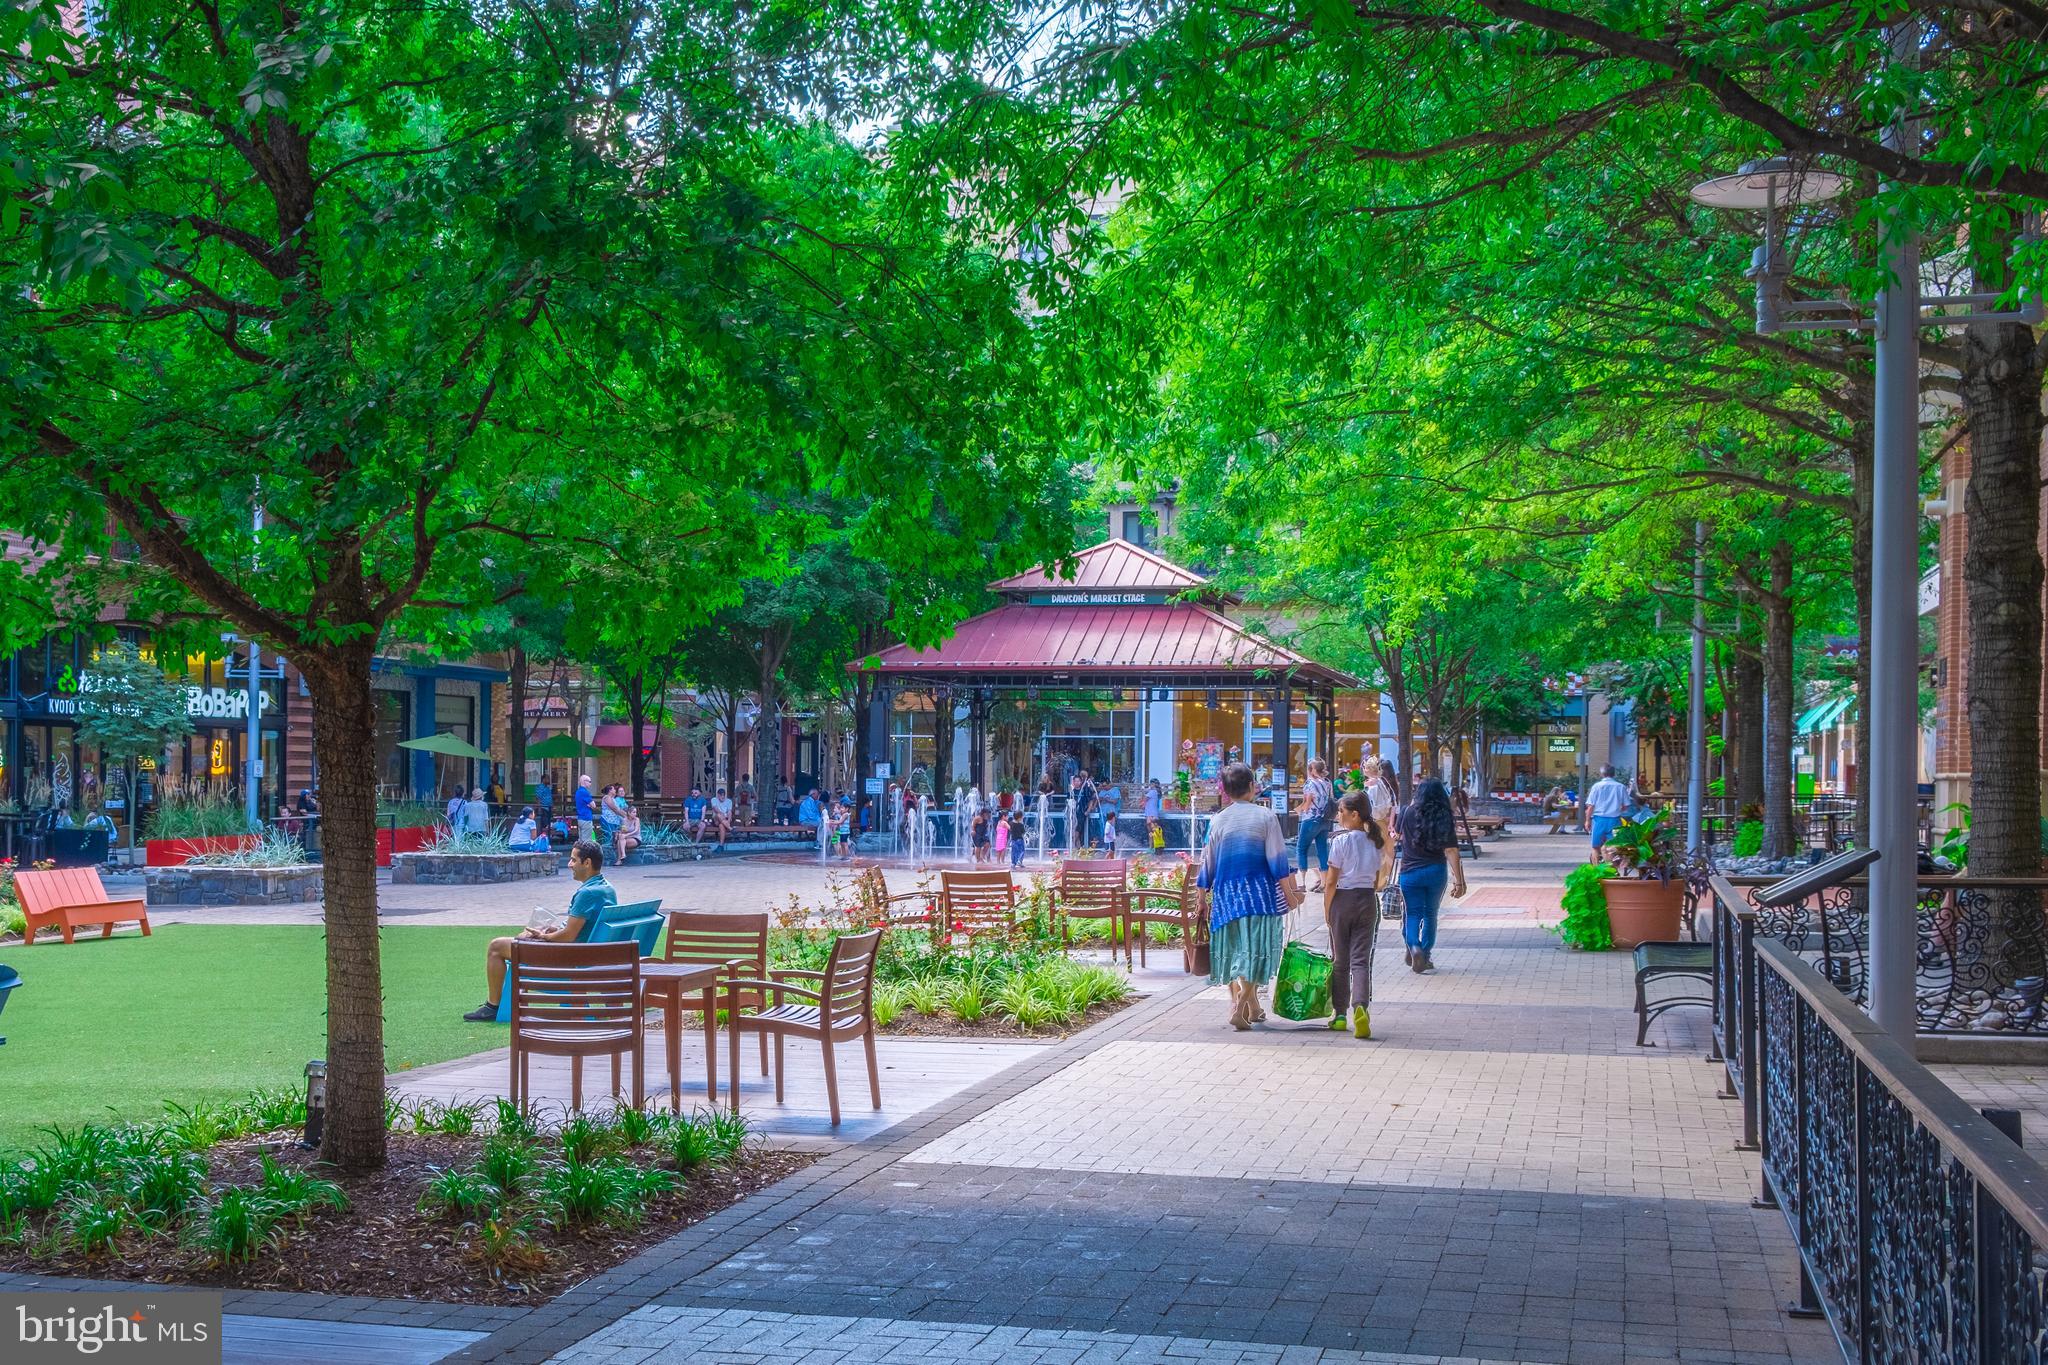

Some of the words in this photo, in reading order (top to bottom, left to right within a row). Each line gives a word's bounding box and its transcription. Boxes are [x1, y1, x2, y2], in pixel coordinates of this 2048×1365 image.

[1051, 592, 1089, 603] DAWSON'S
[1090, 594, 1121, 603] MARKET
[1123, 593, 1145, 603] STAGE
[48, 699, 75, 714] KYOTO
[188, 686, 270, 719] BoBaPP
